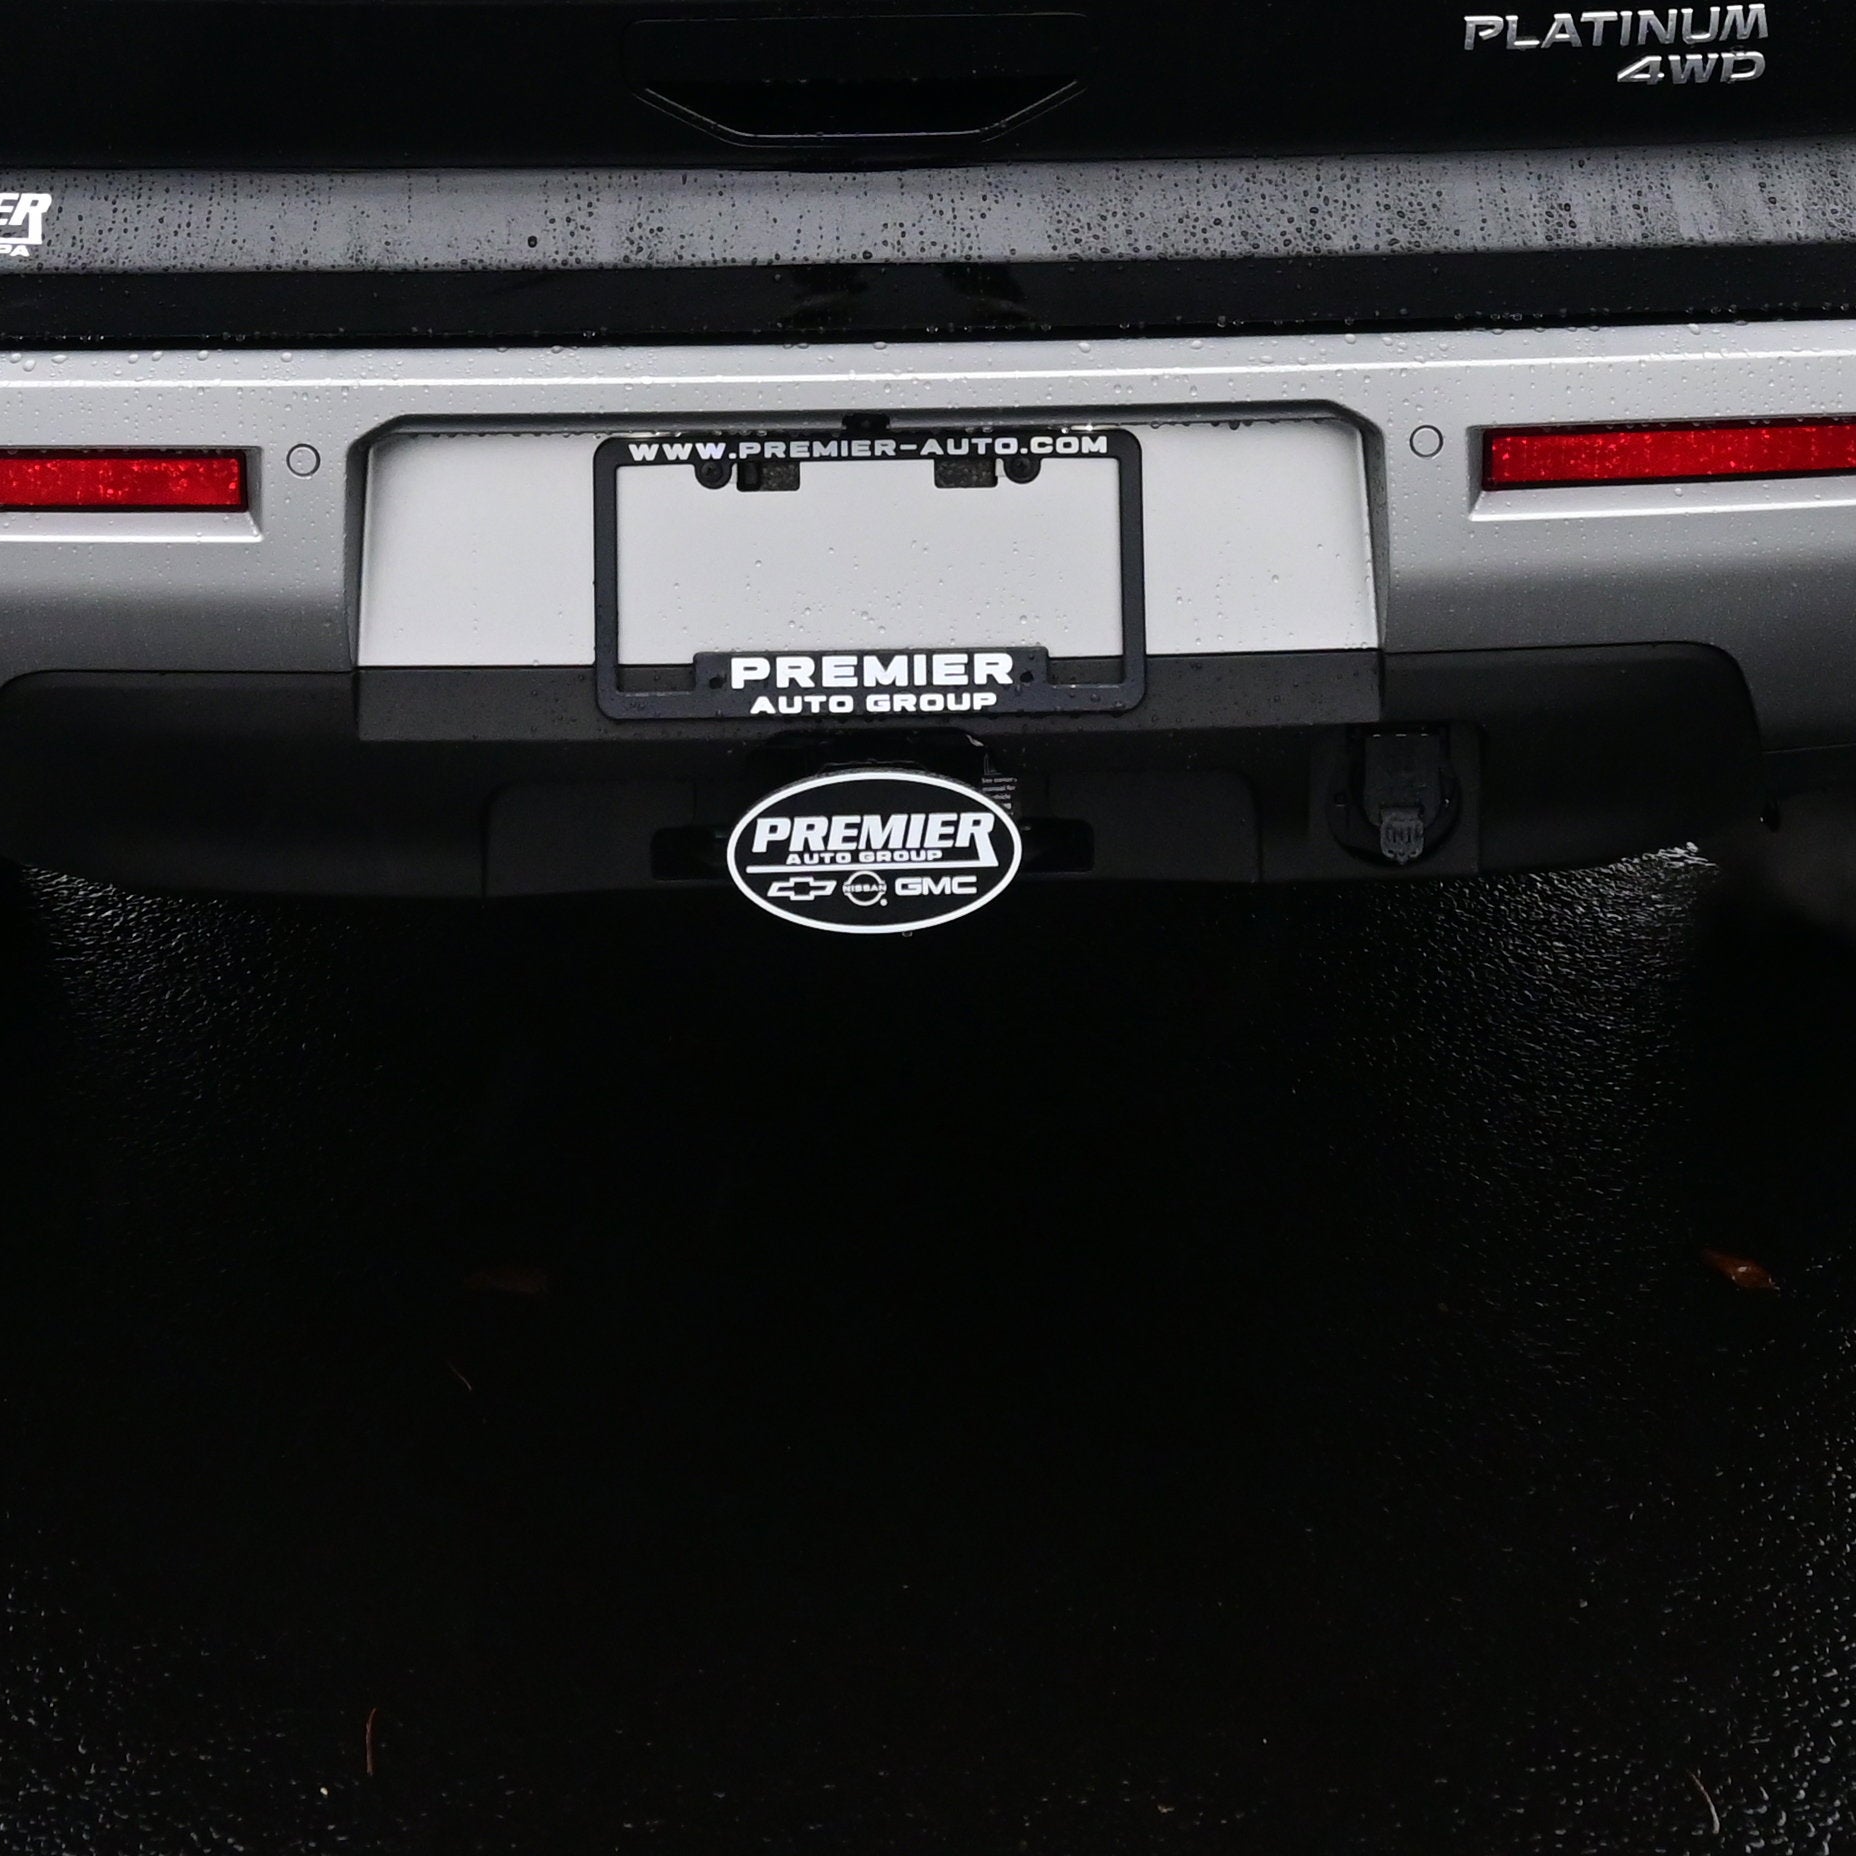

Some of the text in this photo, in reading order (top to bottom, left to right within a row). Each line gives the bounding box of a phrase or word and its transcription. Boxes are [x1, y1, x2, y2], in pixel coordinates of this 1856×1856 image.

[1464, 4, 1769, 51] PLATINUM
[1617, 51, 1766, 85] 4WD
[629, 435, 1108, 462] WWW.PREMIER-AUTO.COM
[730, 652, 1014, 690] PREMIER
[749, 691, 998, 715] AUTO GROUP
[751, 812, 998, 867] PREMIER
[785, 849, 943, 865] AUTO GROUP
[895, 875, 978, 896] GMC
